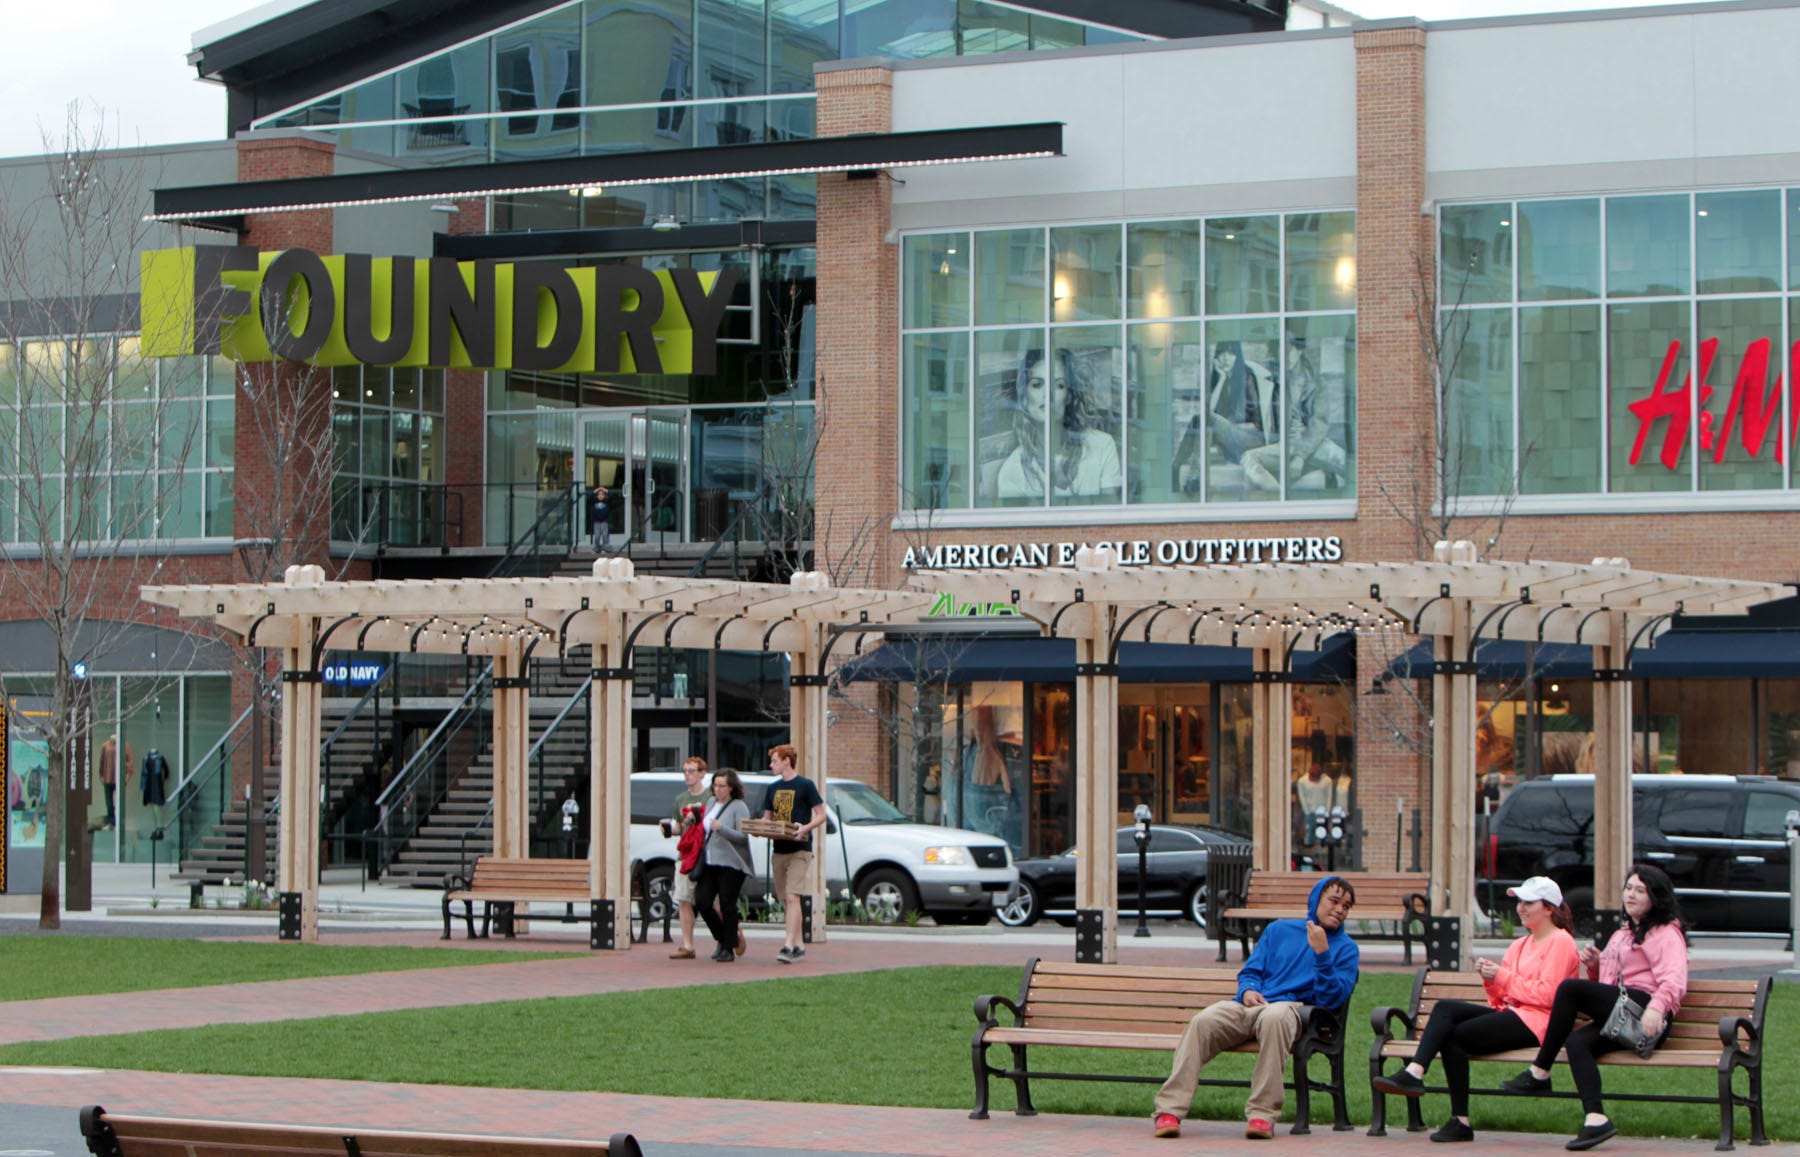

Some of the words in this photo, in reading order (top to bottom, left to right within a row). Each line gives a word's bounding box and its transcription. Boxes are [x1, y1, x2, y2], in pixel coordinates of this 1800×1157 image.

[193, 245, 740, 375] FOUNDRY
[901, 543, 1049, 568] AMERICAN
[1057, 542, 1149, 567] ELE
[1157, 536, 1341, 564] OUTFITTERS
[325, 666, 348, 680] OLD
[350, 666, 379, 680] NAVY
